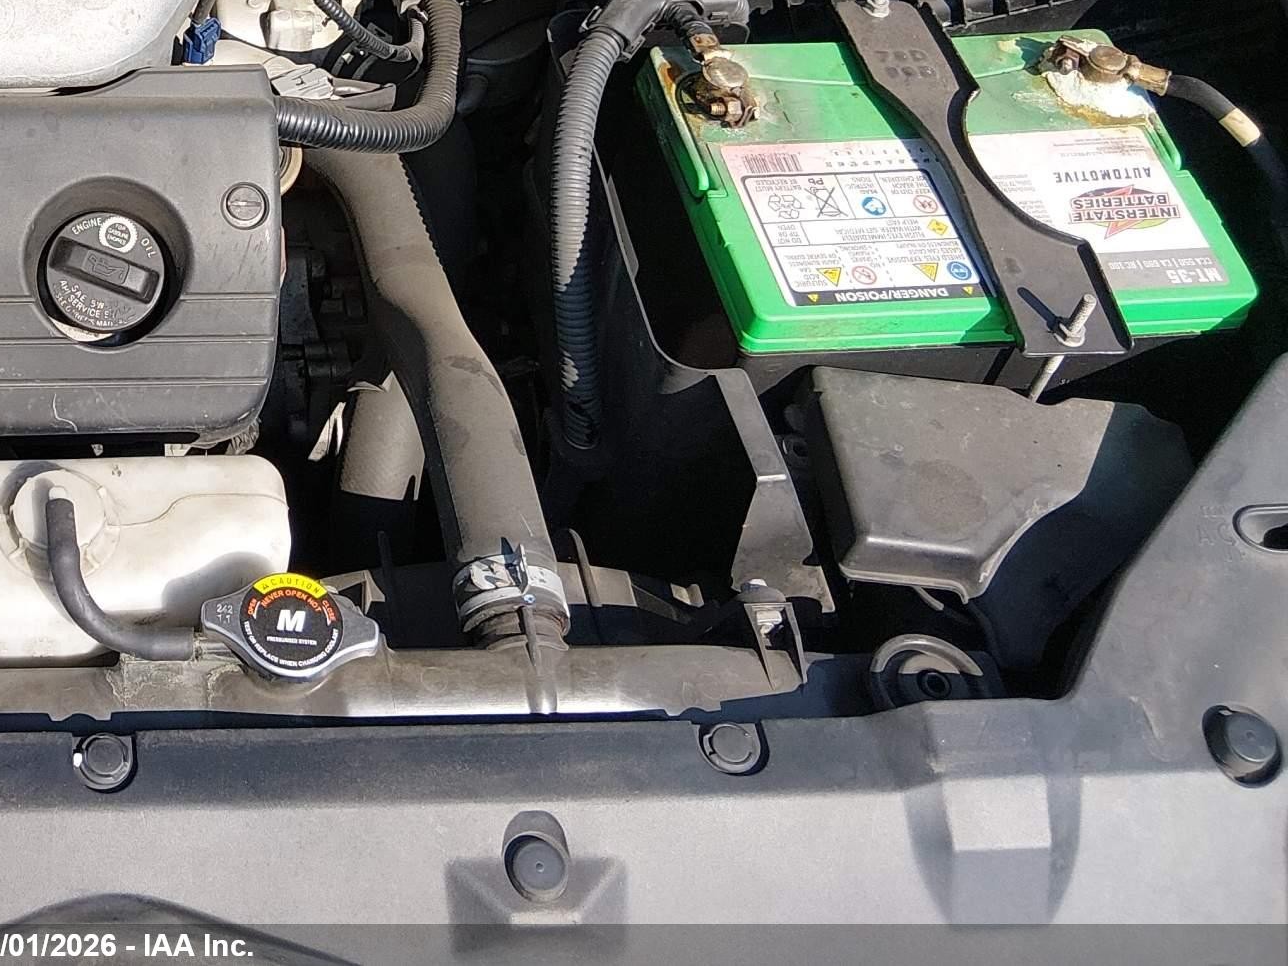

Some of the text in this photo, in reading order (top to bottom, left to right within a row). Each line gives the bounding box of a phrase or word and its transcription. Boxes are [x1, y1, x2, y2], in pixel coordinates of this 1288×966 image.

[1053, 167, 1152, 183] AUTOMOTIVE
[1073, 194, 1167, 209] BATTERIES
[1073, 207, 1178, 222] INTERSTATE
[71, 217, 156, 258] ENGINE OIL
[1165, 268, 1223, 284] MT-35
[71, 284, 88, 302] SAE
[834, 287, 950, 303] DANGER/POISON
[67, 294, 101, 319] SERVICE
[269, 578, 320, 594] CAUTION
[247, 597, 258, 615] OPEN
[261, 590, 322, 612] NEVER OPEN HOT
[276, 609, 306, 632] M
[255, 642, 279, 663] REPLACE
[279, 658, 298, 667] WHEN
